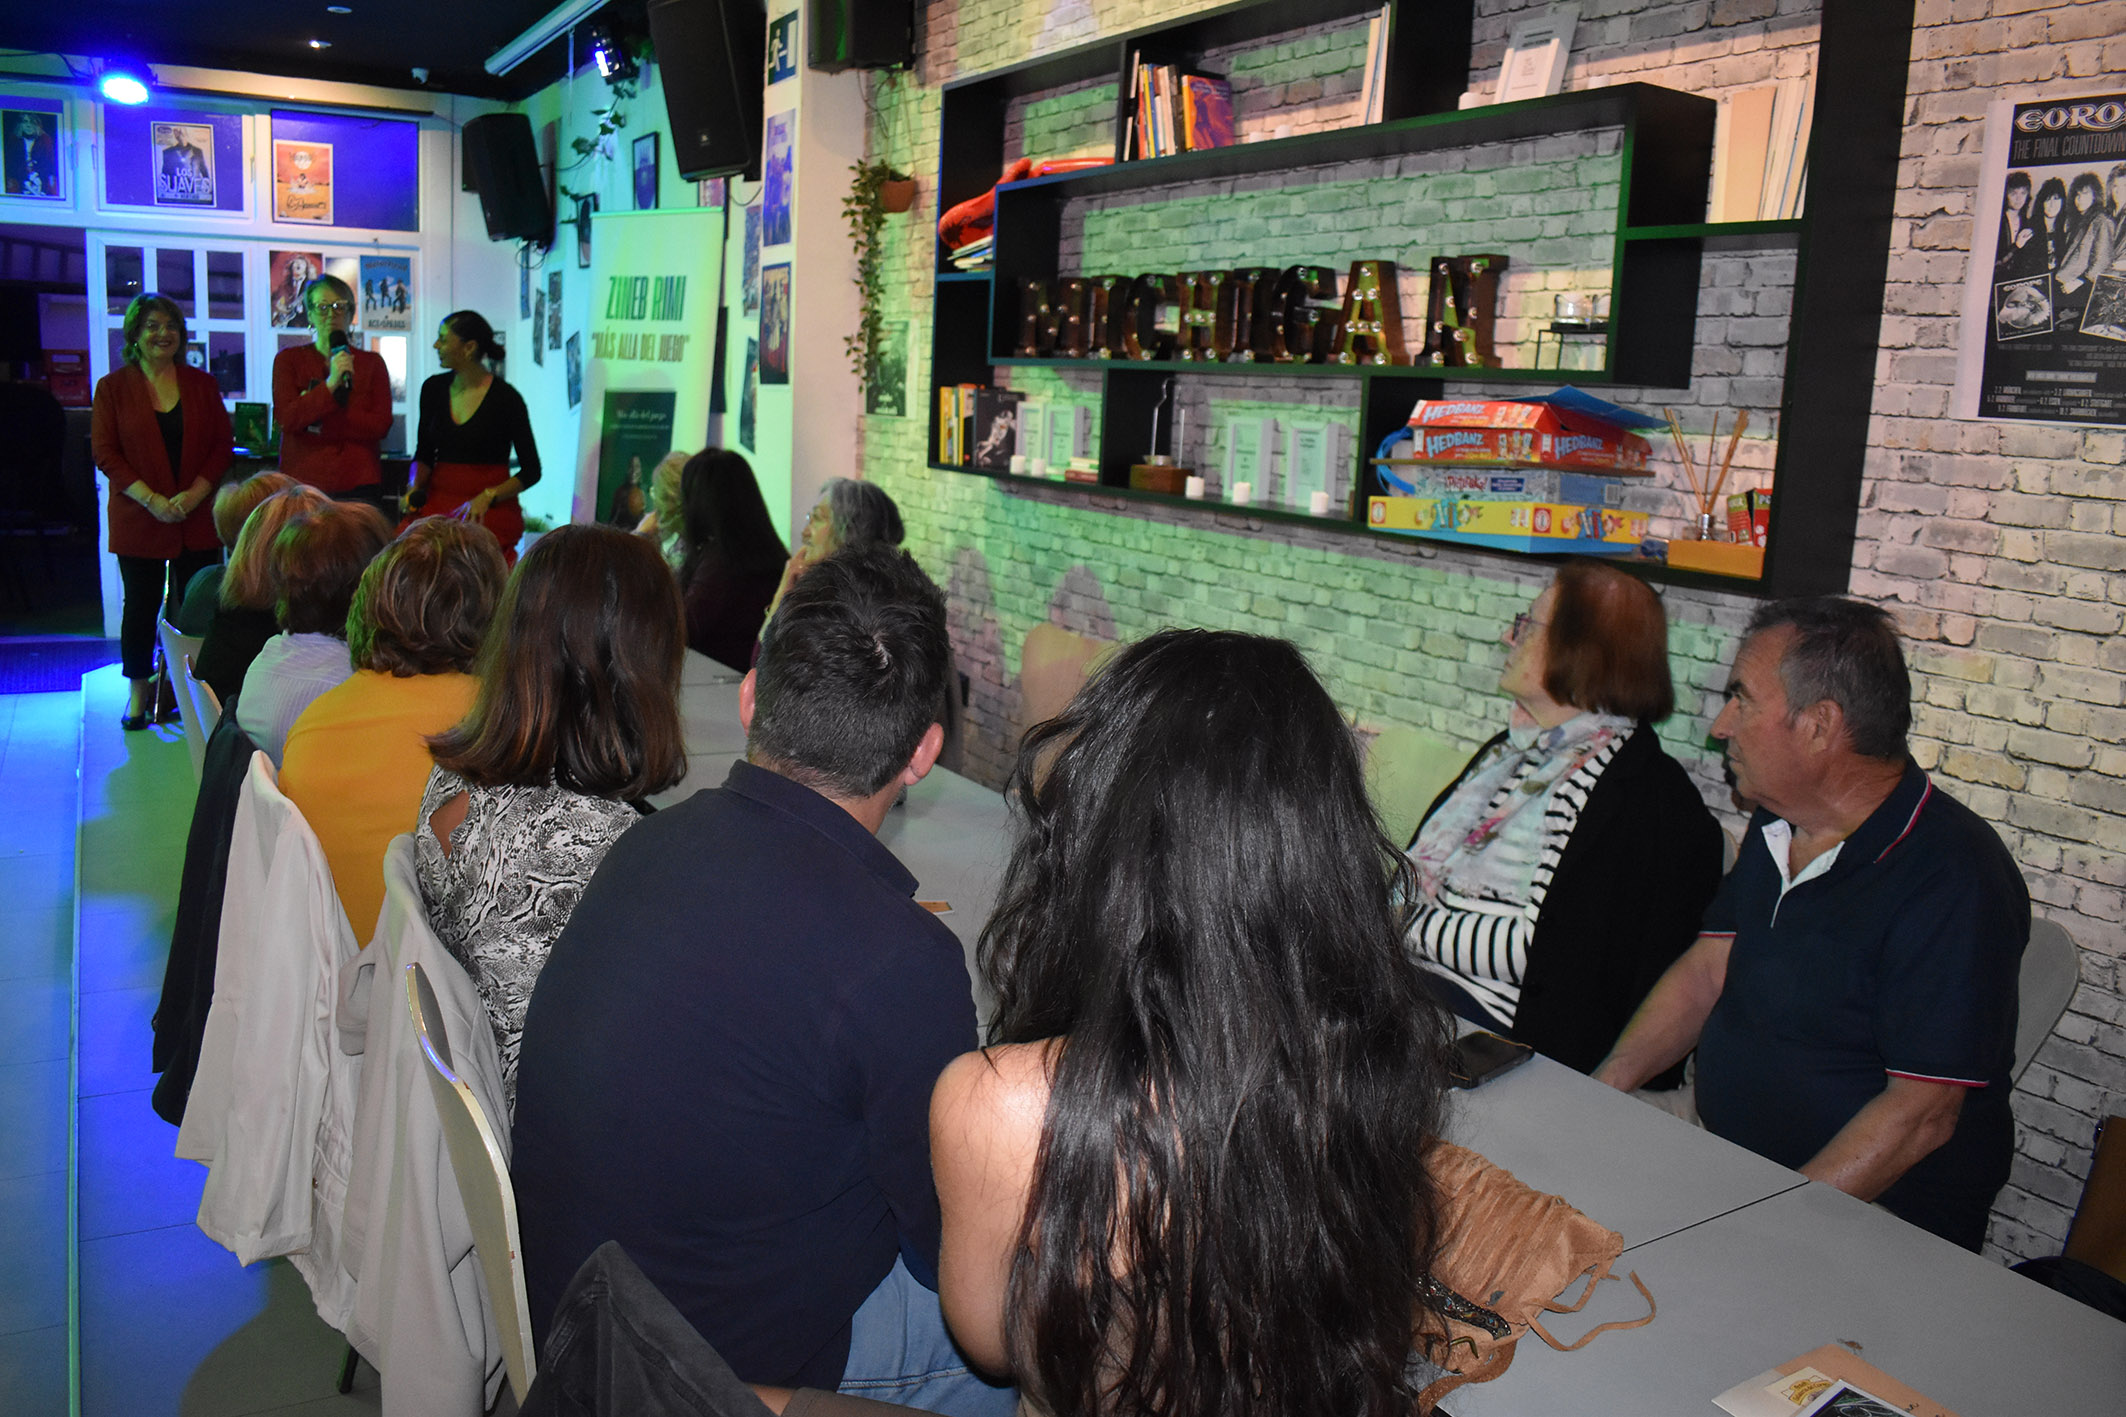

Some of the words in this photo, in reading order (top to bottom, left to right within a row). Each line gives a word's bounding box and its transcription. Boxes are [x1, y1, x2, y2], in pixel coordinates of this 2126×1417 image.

[2013, 139, 2029, 160] THE
[2033, 136, 2060, 158] FINAL
[2062, 131, 2126, 156] COUNTDOWN
[176, 167, 193, 177] LOS
[159, 173, 211, 195] SUAVES
[1422, 403, 1486, 423] HEDBANZ
[1426, 432, 1484, 458] HEDBANZ
